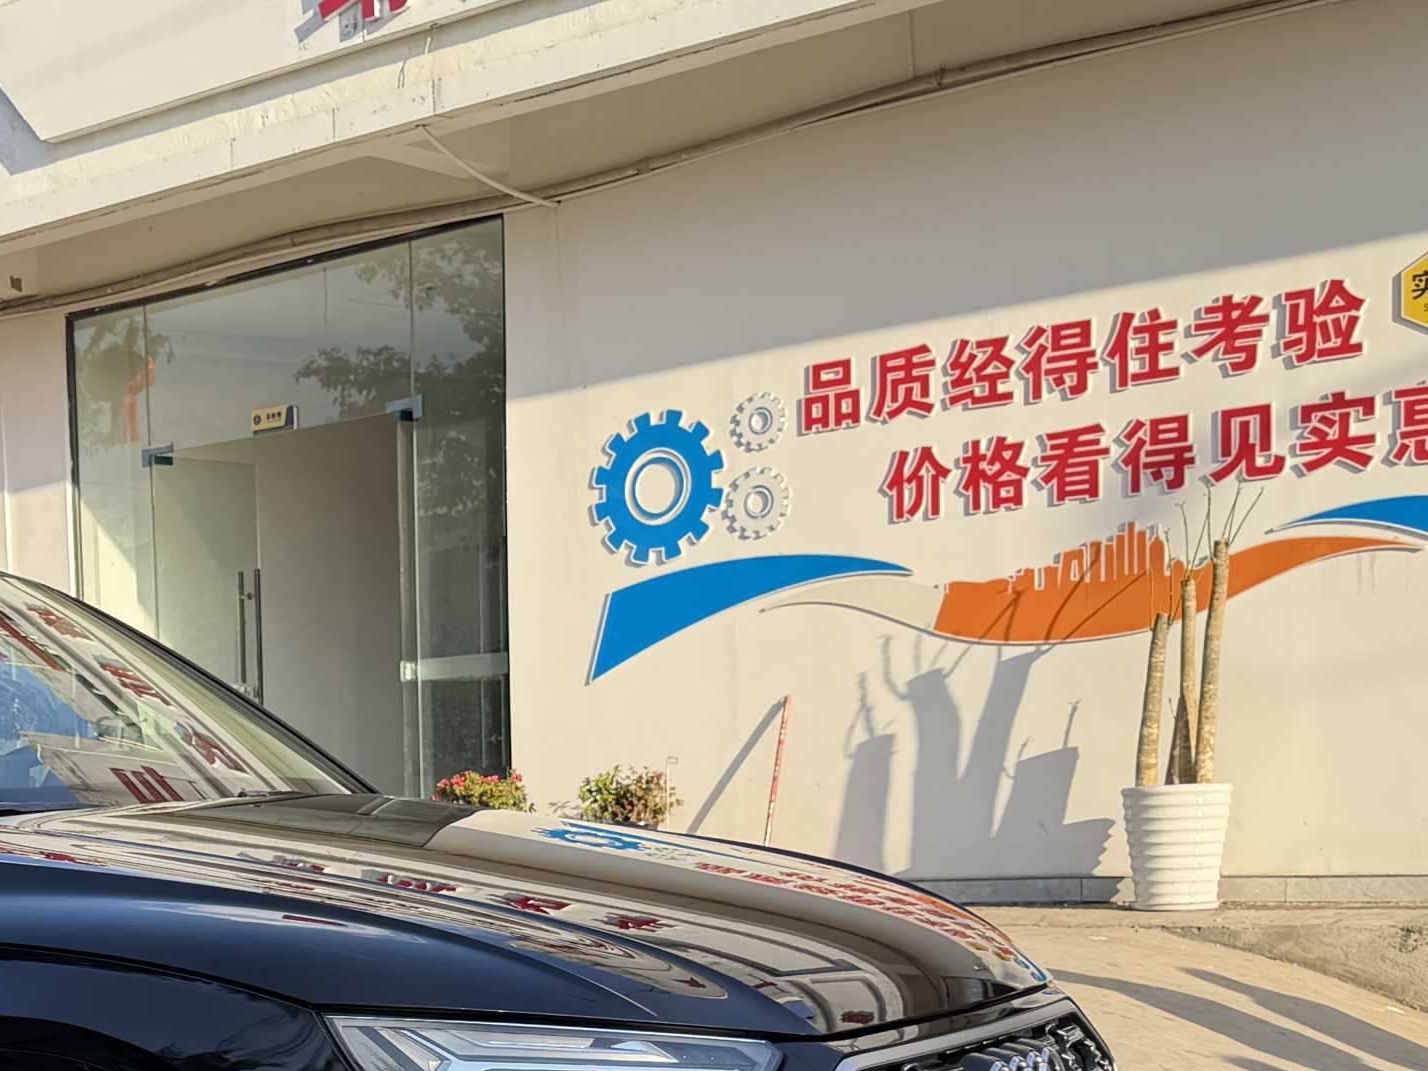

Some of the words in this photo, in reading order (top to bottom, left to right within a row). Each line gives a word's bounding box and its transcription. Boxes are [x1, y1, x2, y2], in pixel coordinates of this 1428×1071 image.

[800, 278, 1368, 435] 品质经得住考验
